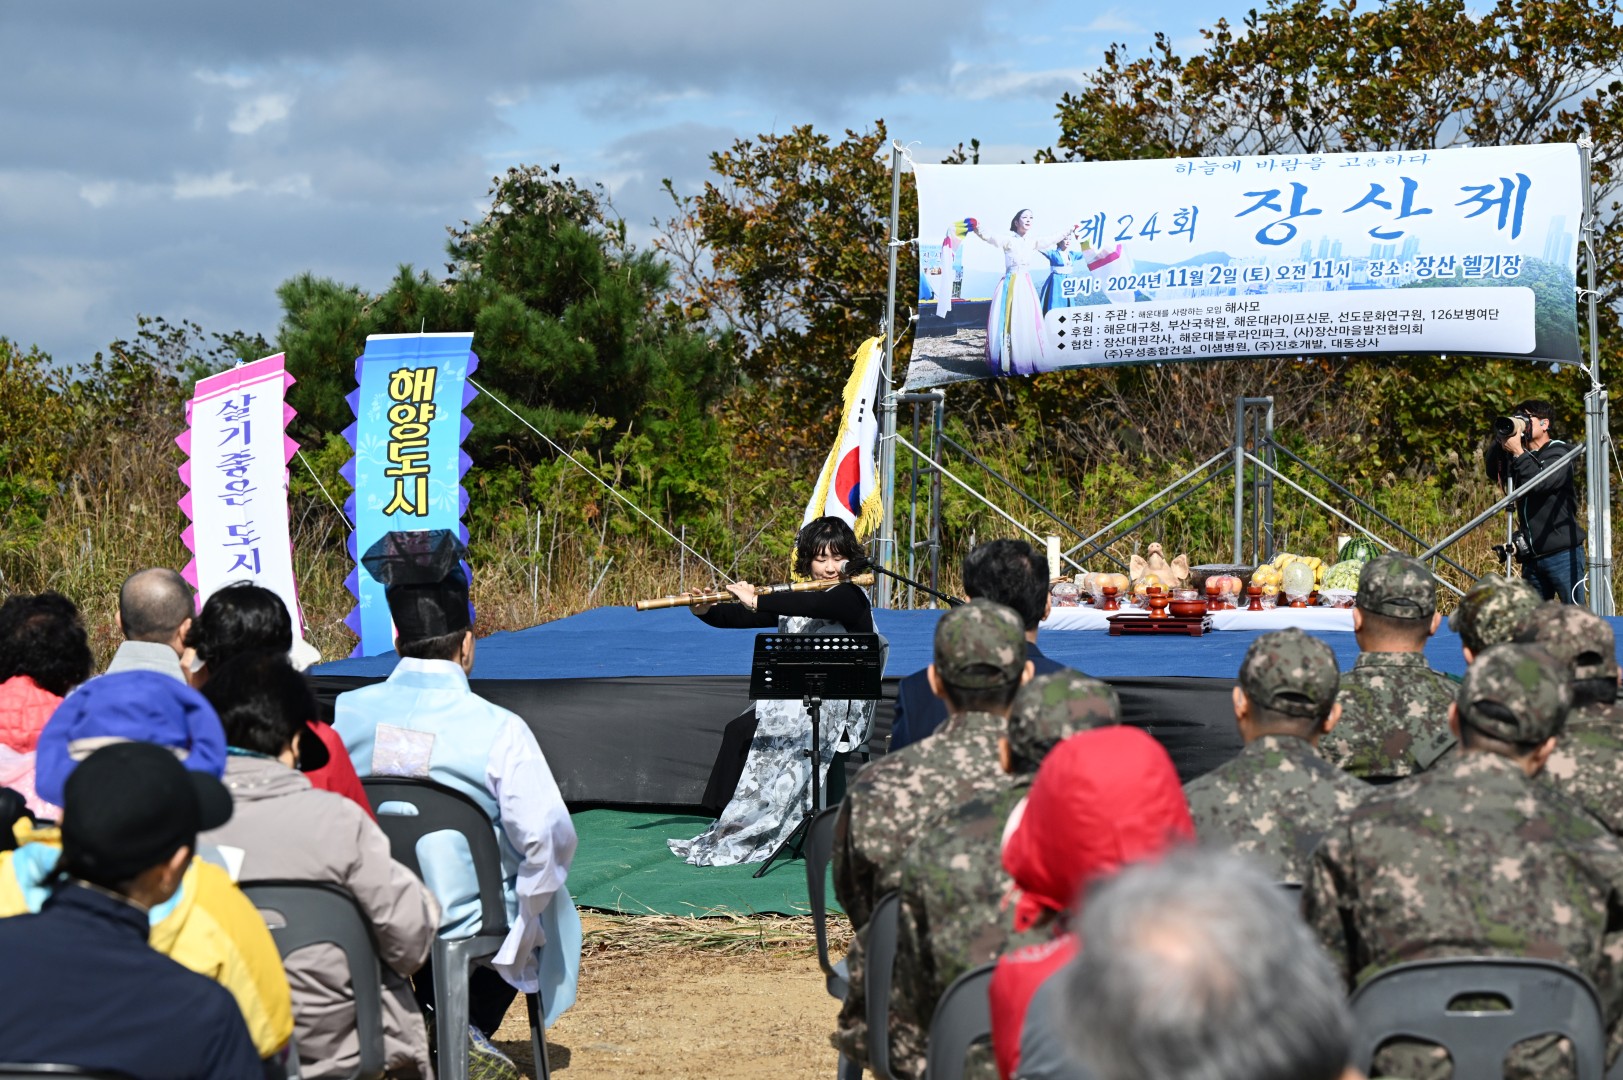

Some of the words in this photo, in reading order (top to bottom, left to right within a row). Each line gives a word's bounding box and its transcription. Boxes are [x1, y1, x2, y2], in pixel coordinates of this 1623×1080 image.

[1175, 159, 1242, 177] 하늘에
[1256, 157, 1326, 172] 바람을
[1077, 205, 1198, 250] 제24회
[1107, 273, 1161, 291] 2024년
[1166, 268, 1204, 287] 11월
[1208, 265, 1238, 285] 2일
[1243, 266, 1270, 283] (토)
[1275, 264, 1307, 281] 오전
[1311, 259, 1350, 279] 11시
[1415, 254, 1457, 277] 장산
[1462, 254, 1522, 277] 헬기장
[1071, 311, 1094, 324] 주최
[1104, 309, 1128, 322] 주관
[1138, 308, 1169, 319] 해운대를
[1171, 306, 1203, 317] 사랑하는
[1206, 305, 1222, 315] 모임
[1225, 300, 1260, 314] 해사모
[1071, 325, 1094, 338] 후원
[1103, 320, 1164, 335] 해운대구청,
[1167, 315, 1230, 331] 부산국학원,
[1234, 311, 1333, 328] 해운대라이프신문,
[1337, 309, 1426, 323] 선도문화연구원,
[1431, 307, 1500, 321] 126보병여단
[1071, 338, 1093, 351] 협찬
[1103, 334, 1175, 348] 장산대원각사,
[1179, 327, 1289, 344] 해운대블루라인파크,
[1293, 322, 1424, 339] (사)장산마을발전협의회
[1103, 344, 1196, 360] (주)우성종합건설,
[1254, 337, 1327, 353] (주)진호개발,
[1331, 337, 1380, 349] 대동상사
[382, 365, 437, 517] 해양도시
[222, 519, 261, 575] 도시
